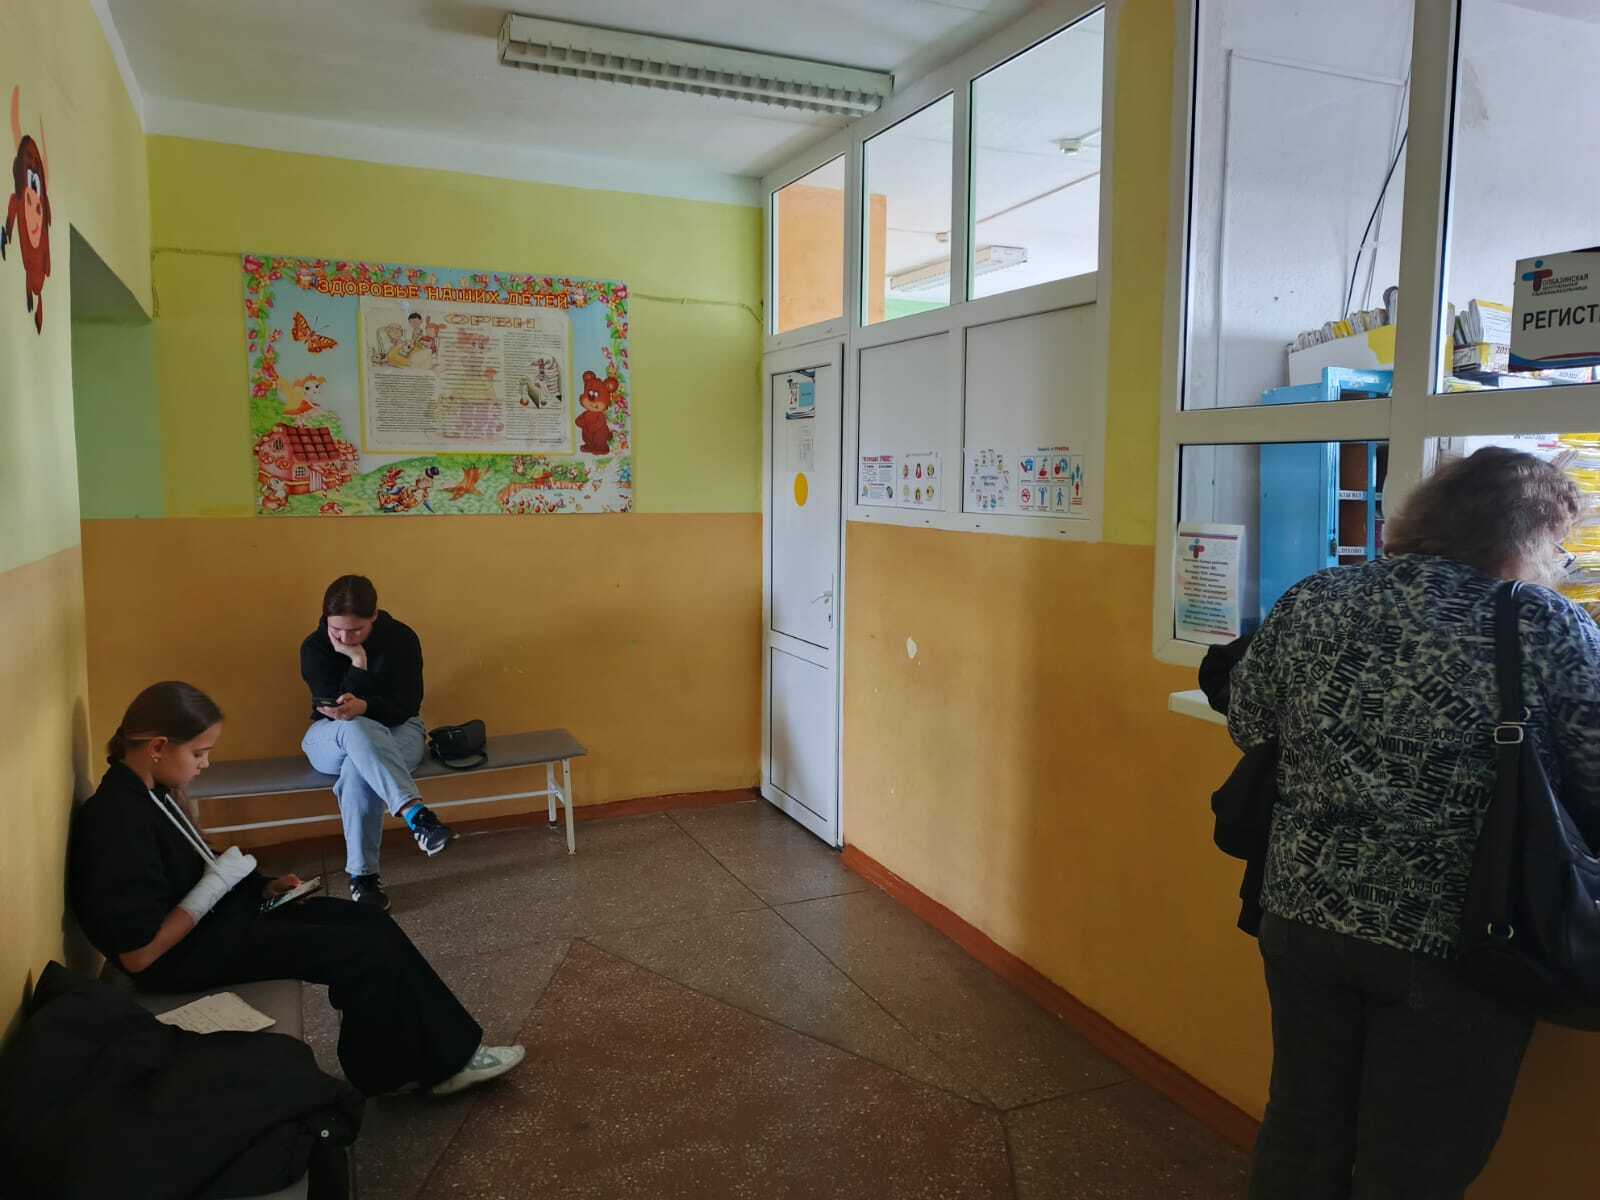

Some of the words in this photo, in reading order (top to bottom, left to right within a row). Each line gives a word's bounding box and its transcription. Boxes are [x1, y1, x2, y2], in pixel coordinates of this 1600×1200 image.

[318, 279, 419, 298] ЗДОРОВЬЕ
[427, 286, 499, 304] НАШИХ
[508, 291, 569, 309] ДЕТЕЙ
[446, 312, 535, 328] ОРВИ
[1523, 303, 1600, 331] РЕГИСТ
[1317, 641, 1371, 718] VALENTINE
[1361, 688, 1385, 722] LOVE
[1411, 674, 1481, 731] HEART
[1375, 734, 1424, 757] HOLIDAY
